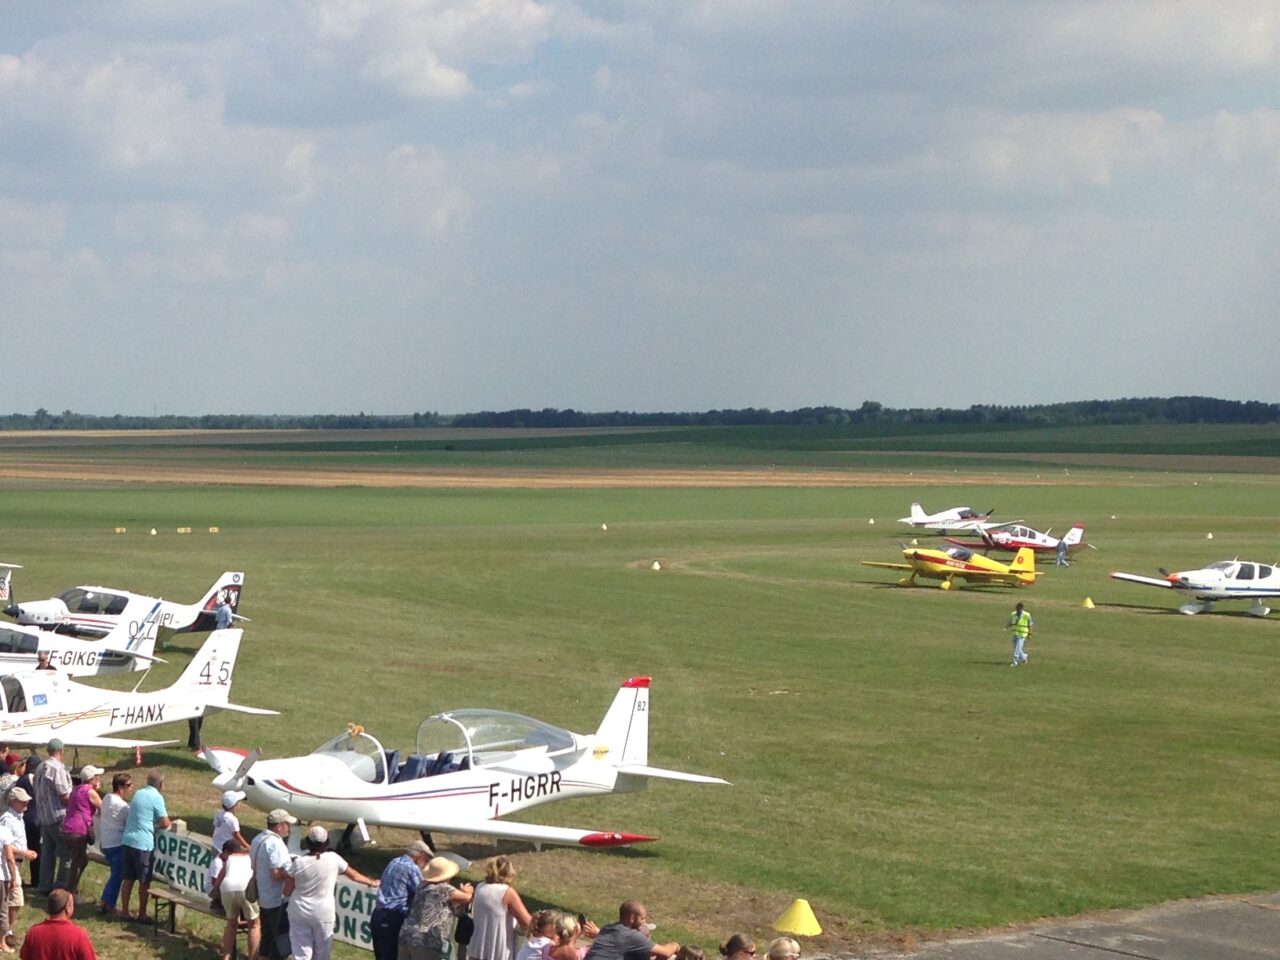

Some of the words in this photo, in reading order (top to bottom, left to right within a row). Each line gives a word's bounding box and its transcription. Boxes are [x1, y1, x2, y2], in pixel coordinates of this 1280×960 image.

[48, 649, 98, 666] F-GIKG
[199, 661, 230, 683] 45
[109, 703, 166, 727] F-HANX
[637, 700, 646, 711] 82
[489, 770, 562, 807] F-HGRR
